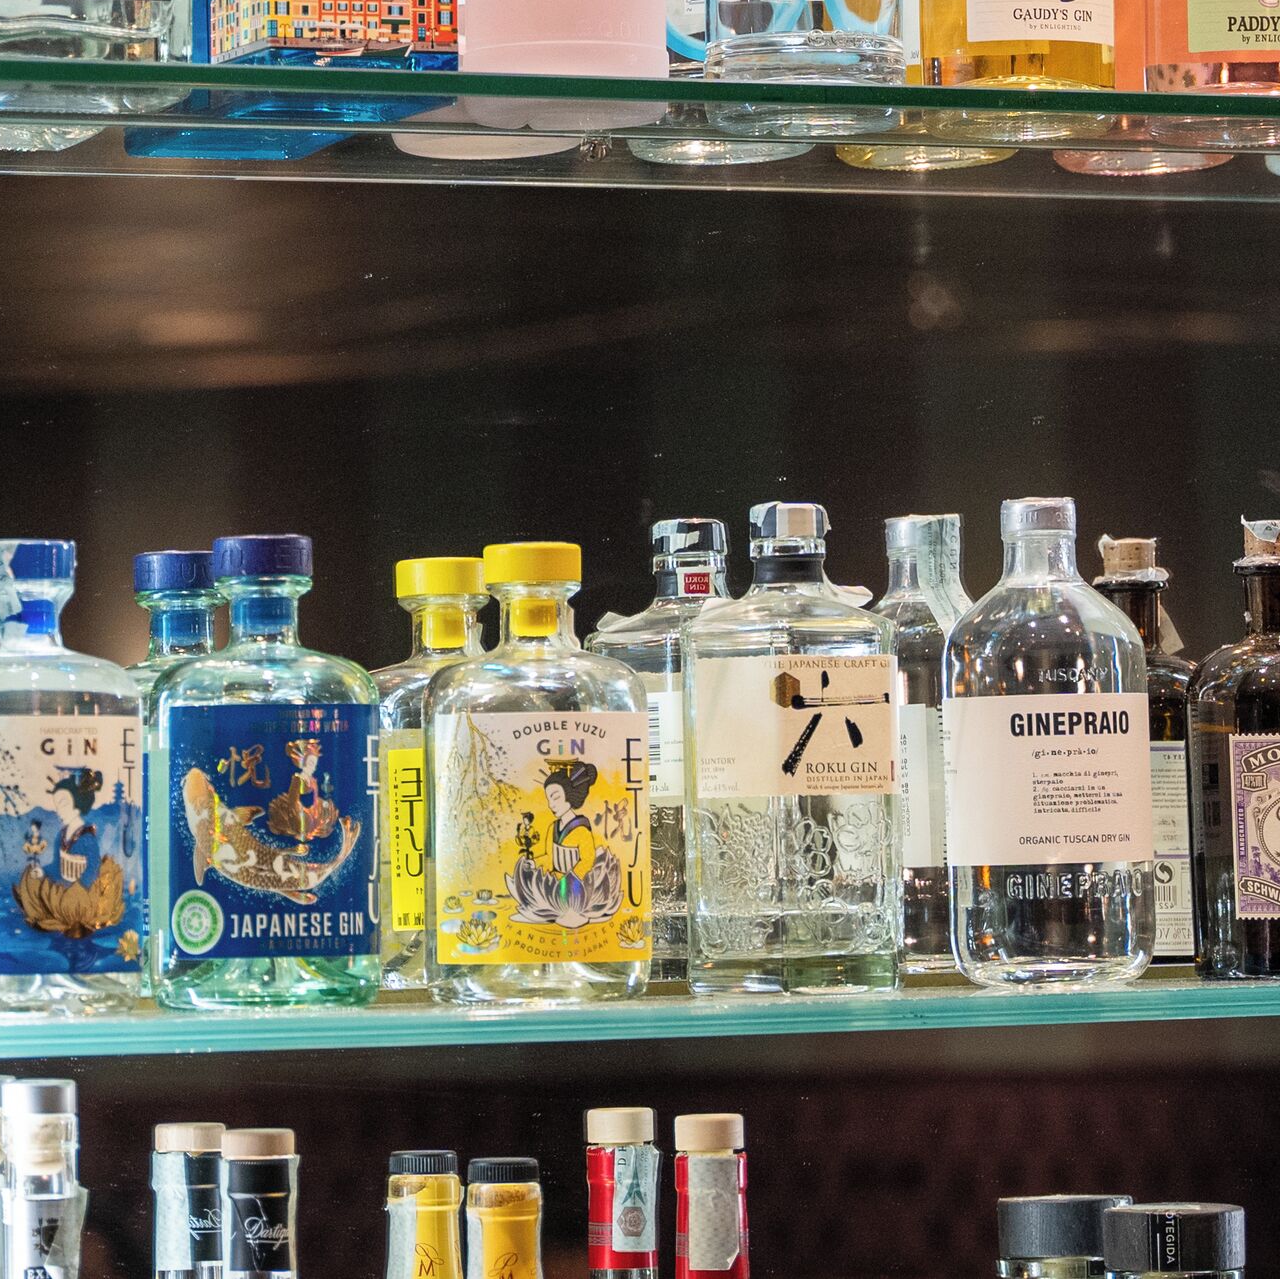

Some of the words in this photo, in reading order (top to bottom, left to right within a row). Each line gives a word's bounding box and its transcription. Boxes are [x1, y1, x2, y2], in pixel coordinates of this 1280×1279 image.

[1013, 8, 1068, 21] GAUDY'S
[1074, 10, 1093, 22] GIN
[1242, 35, 1250, 44] by
[789, 660, 839, 670] JAPANESE
[844, 660, 876, 668] CRAFT
[1010, 710, 1129, 736] GINEPRAIO
[513, 721, 568, 740] DOUBLE
[575, 722, 607, 739] YUZU
[806, 762, 846, 773] ROKU
[851, 762, 877, 772] GIN
[1019, 836, 1060, 845] ORGANIC
[1064, 835, 1099, 843] TUSCAN
[1119, 834, 1130, 842] GIN
[231, 913, 332, 938] JAPANESE
[340, 912, 364, 935] GIN
[514, 940, 561, 958] PRODUCT
